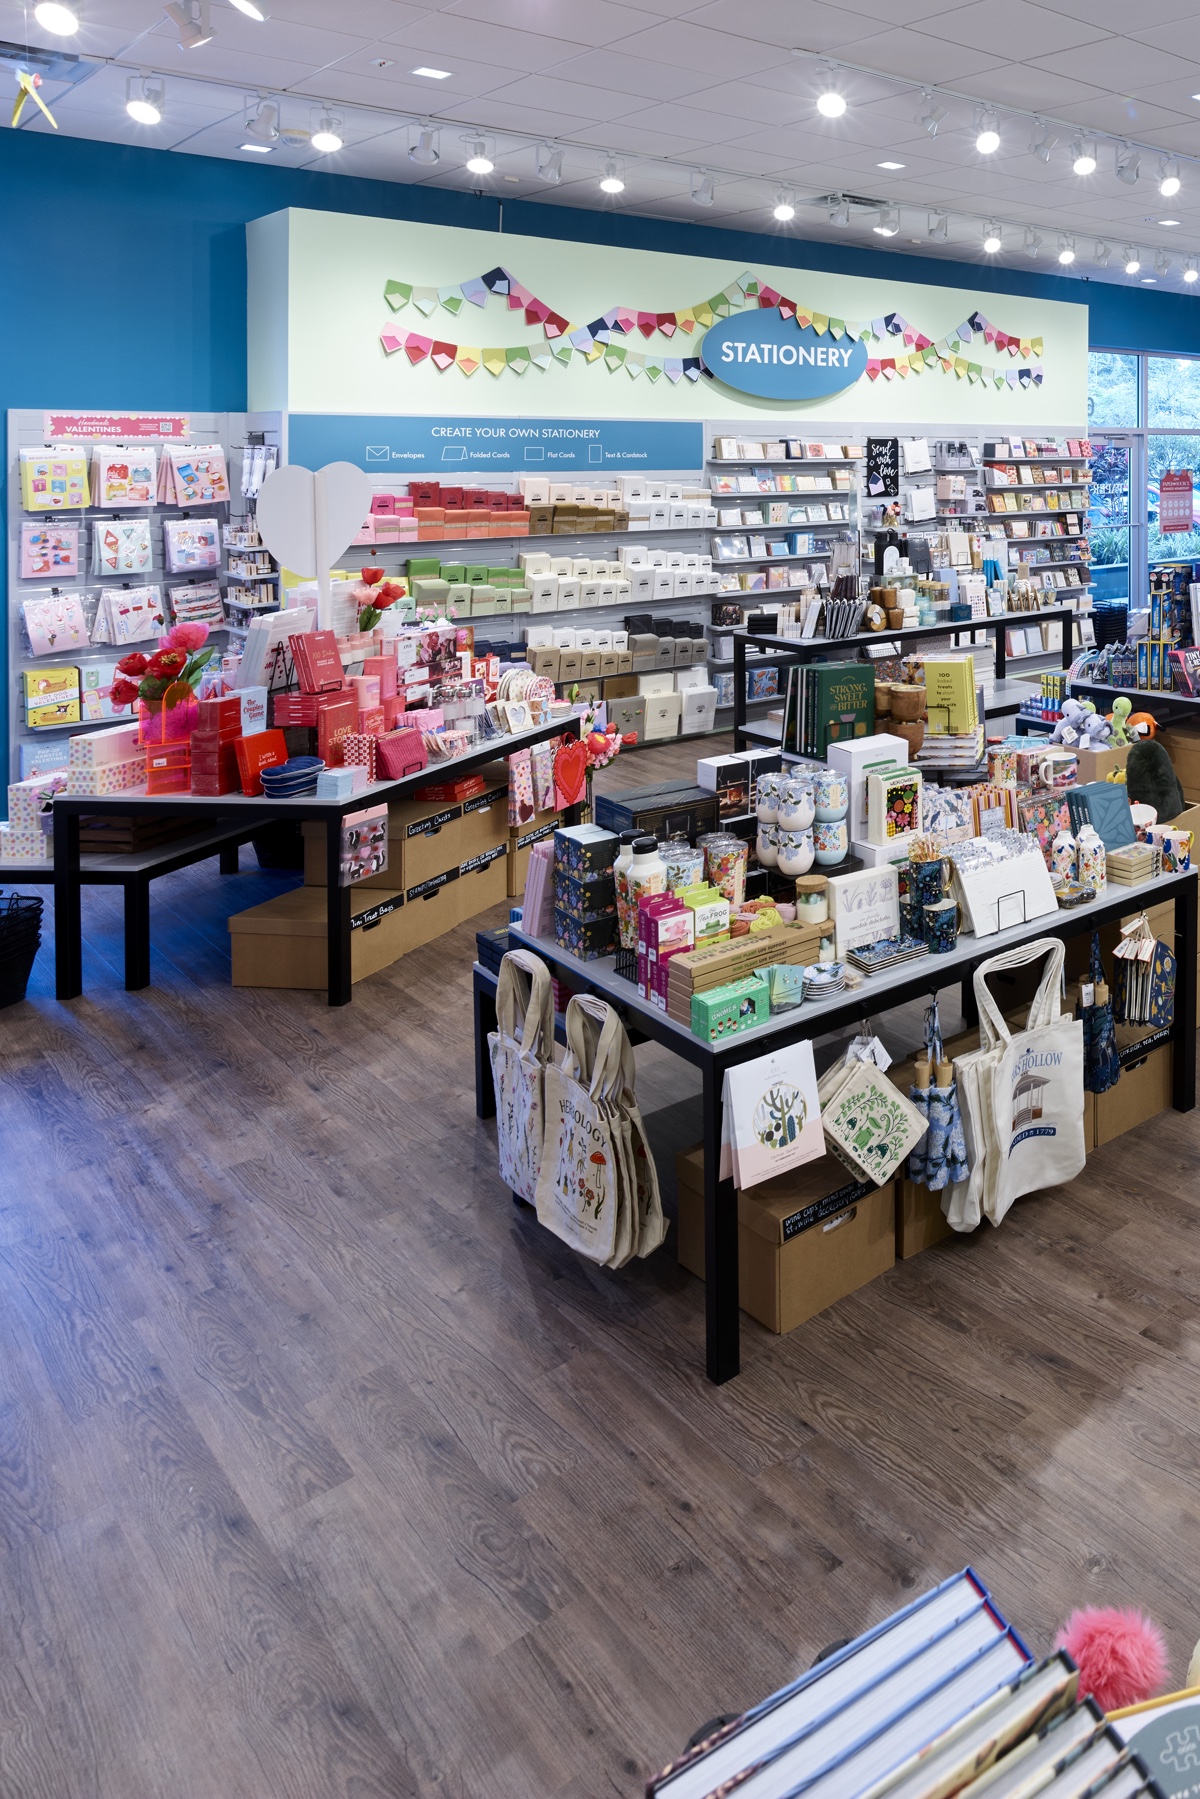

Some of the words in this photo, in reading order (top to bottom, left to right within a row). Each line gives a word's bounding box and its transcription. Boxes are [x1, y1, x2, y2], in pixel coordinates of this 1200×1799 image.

[721, 341, 853, 367] STATIONERY
[431, 427, 472, 437] CREATE
[475, 428, 506, 438] YOUR
[508, 428, 539, 438] OWN
[541, 428, 601, 438] STATIONERY
[392, 452, 425, 460] Envelopes
[876, 454, 894, 465] with
[879, 464, 897, 476] love
[1185, 650, 1200, 661] TINY
[830, 682, 868, 694] STRONG,
[34, 694, 74, 705] VALENTINES
[38, 692, 54, 700] HOT
[54, 690, 68, 698] DOG
[834, 692, 864, 702] SWEET
[243, 704, 264, 714] Couples
[838, 700, 868, 711] BITTER
[248, 710, 264, 719] Game
[334, 726, 352, 737] LOVE
[890, 777, 914, 786] WILDFLOWERS
[464, 798, 488, 812] Greeting
[489, 790, 502, 802] Cards
[408, 821, 432, 836] Greeting
[434, 812, 452, 825] Cards
[379, 904, 394, 916] Bags
[698, 911, 709, 922] Tea
[710, 908, 728, 920] FROG
[850, 922, 868, 931] swedish
[868, 914, 891, 927] dishcloths
[687, 948, 717, 960] MINI
[690, 950, 718, 963] LIFE
[718, 934, 774, 957] SUPPORT
[742, 951, 757, 960] PLANT
[758, 947, 766, 955] LIFE
[767, 941, 787, 952] SUPPORT
[744, 961, 758, 969] PLANT
[758, 957, 767, 965] LIFE
[768, 950, 787, 962] SUPPORT
[712, 1004, 737, 1022] GNOMES
[1022, 1052, 1063, 1071] HOLLOW
[785, 1214, 802, 1227] wine
